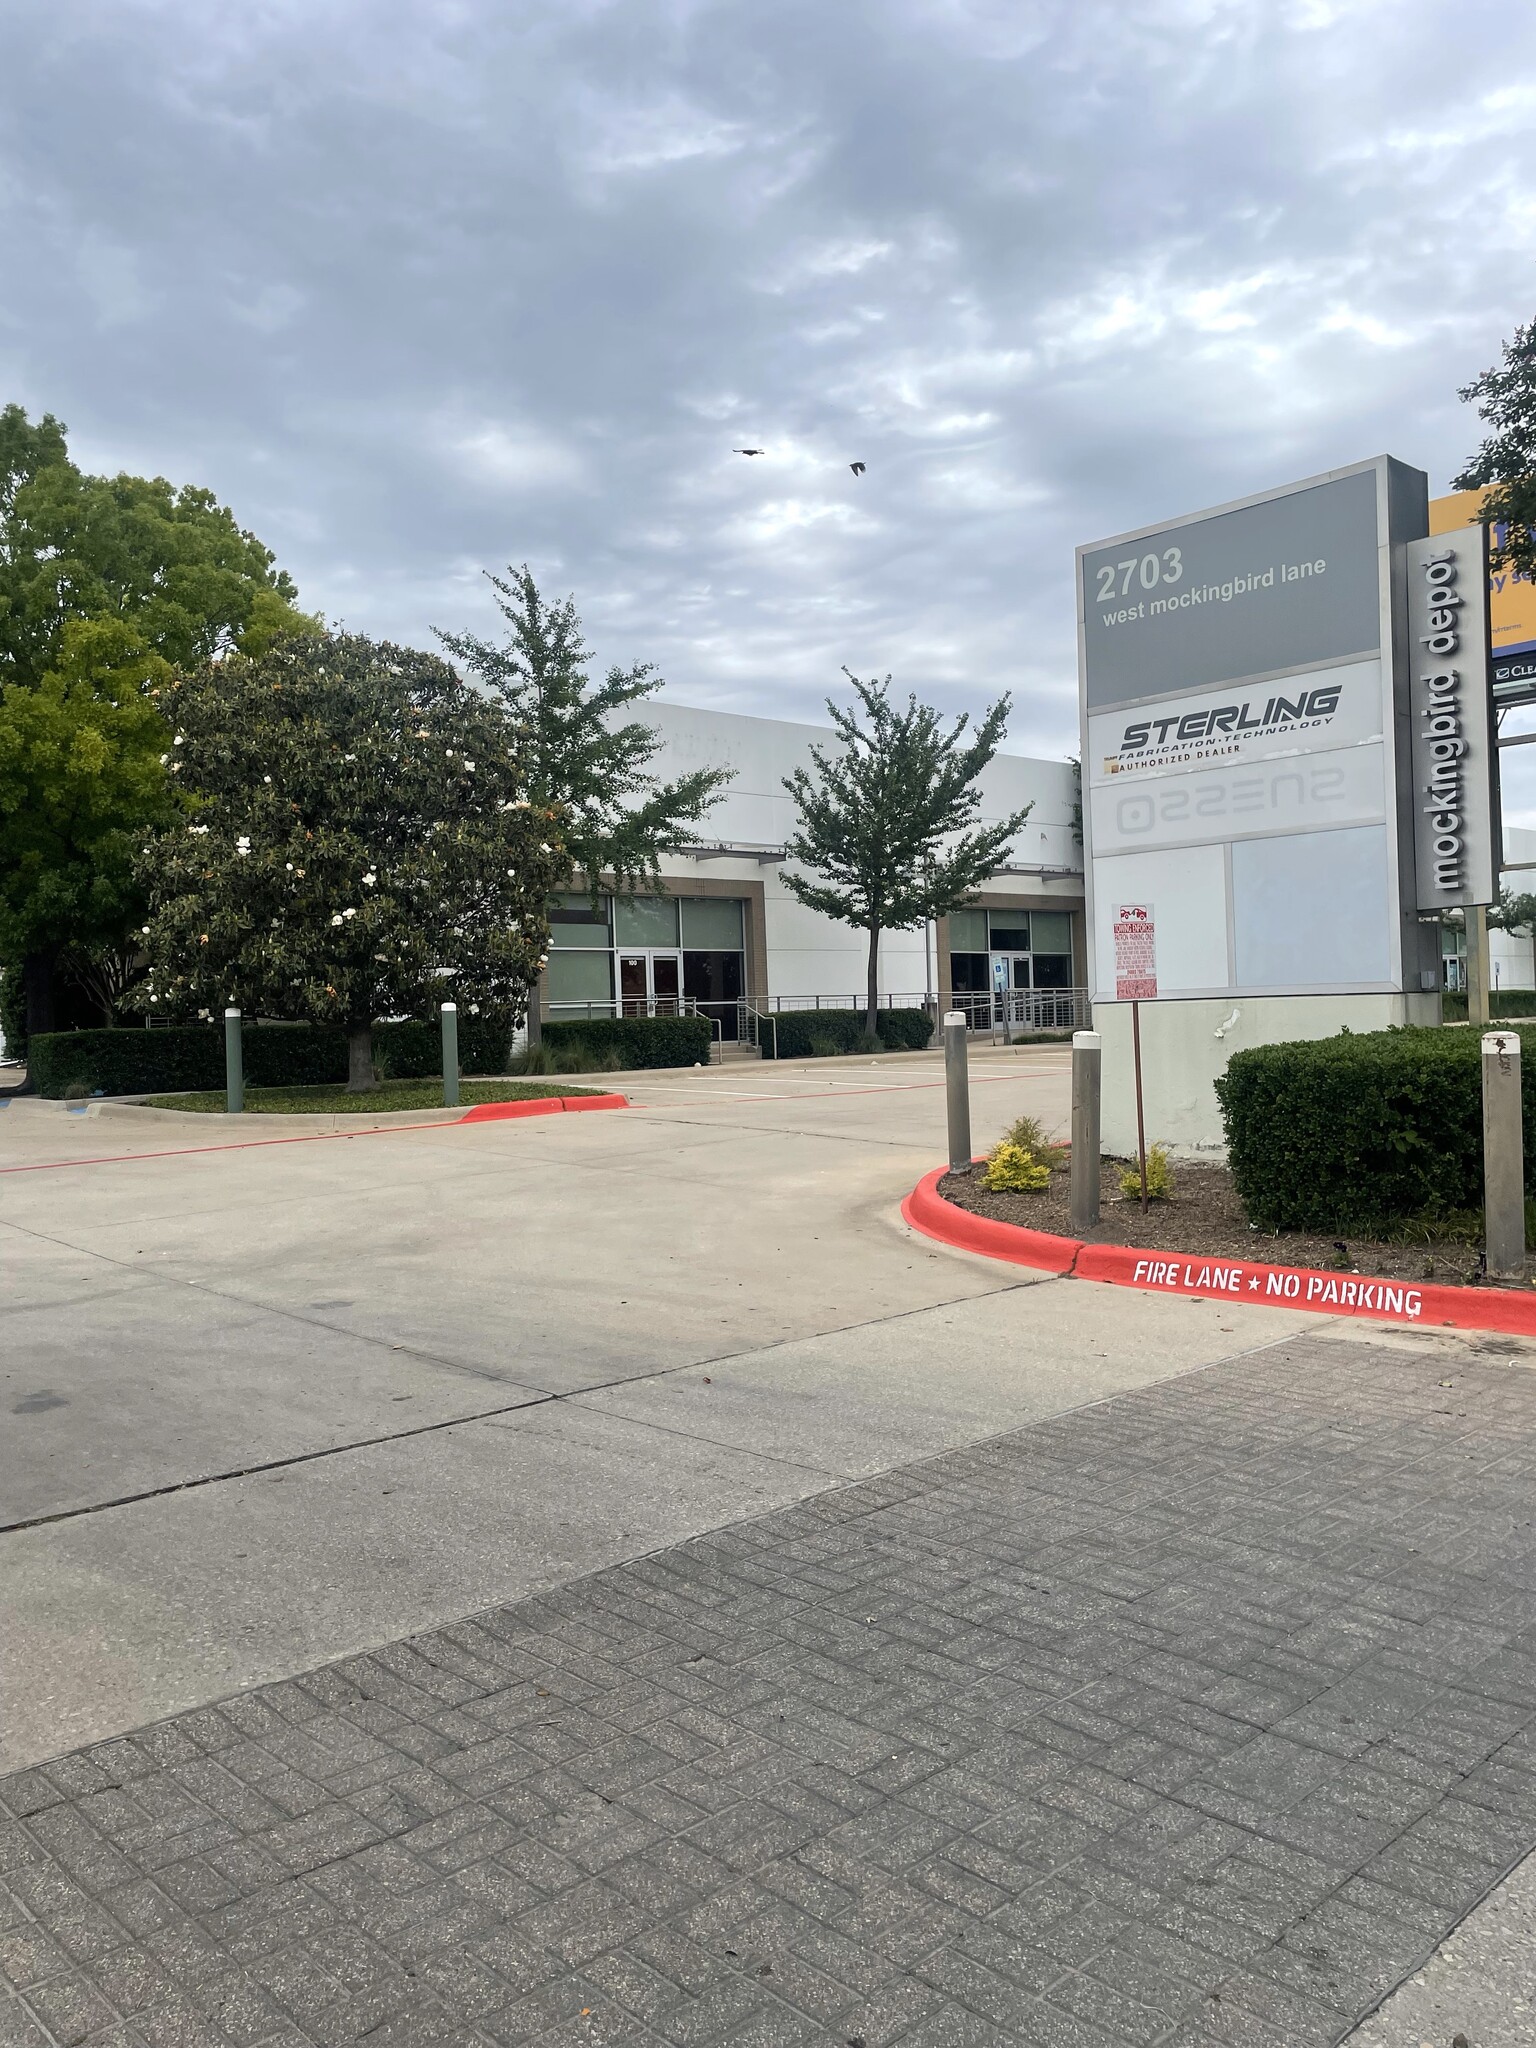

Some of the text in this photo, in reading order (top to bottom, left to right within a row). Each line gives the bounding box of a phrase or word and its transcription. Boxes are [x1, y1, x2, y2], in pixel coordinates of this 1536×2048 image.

[1096, 547, 1183, 602] 2703
[1103, 559, 1327, 627] west mockingbird lane
[1420, 549, 1461, 655] depot
[1118, 716, 1334, 761] FABRICATION TECHNOLOGY
[1121, 685, 1343, 752] STERLING
[1119, 745, 1241, 773] AUTHORIZED DEALER
[1421, 670, 1467, 890] mockingbird
[1133, 1260, 1422, 1316] FIRE LANE NO PARKING
